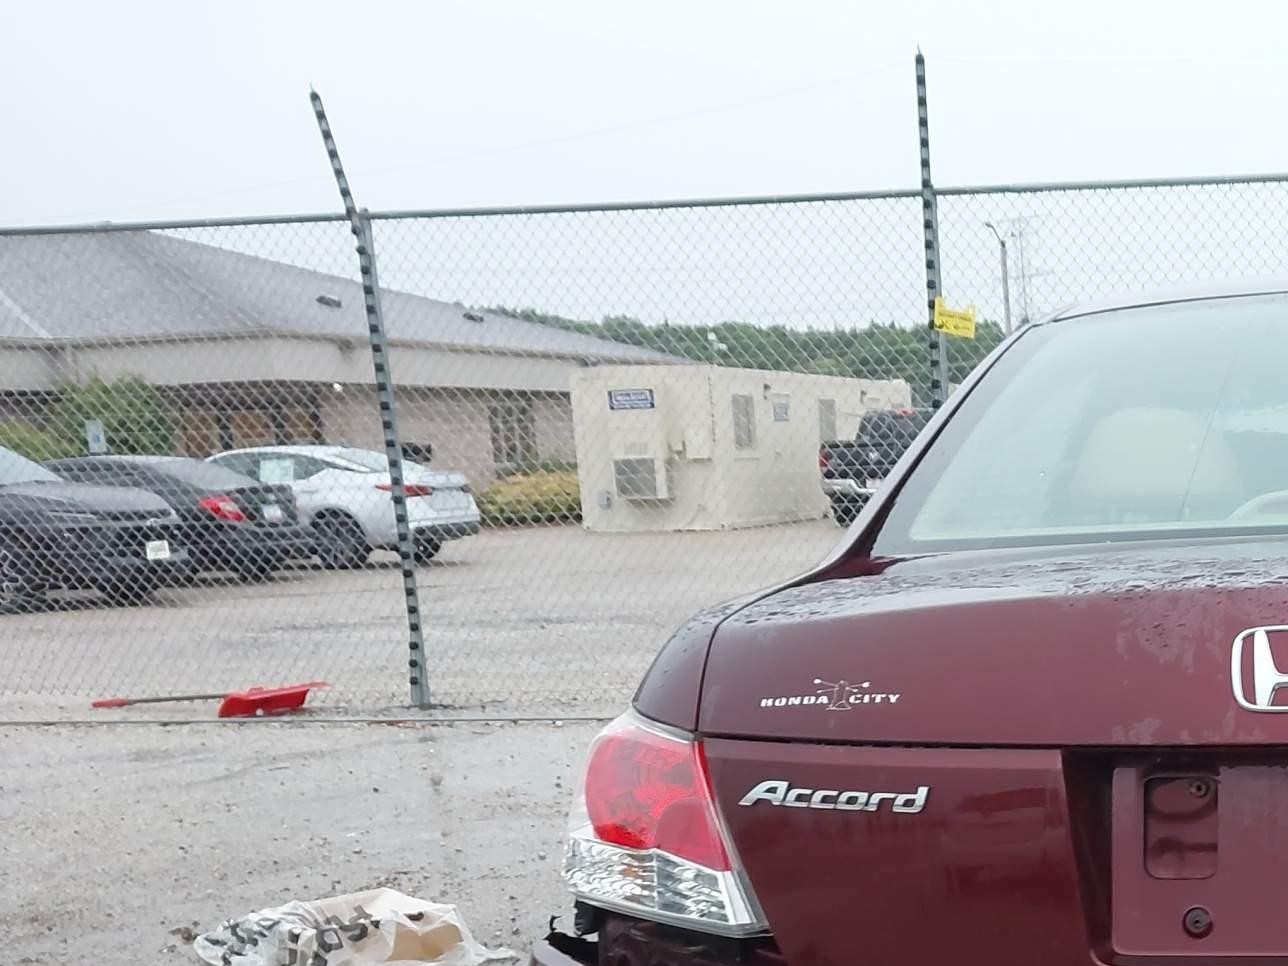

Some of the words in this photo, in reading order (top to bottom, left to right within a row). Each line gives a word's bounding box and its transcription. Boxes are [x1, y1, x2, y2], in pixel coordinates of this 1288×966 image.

[760, 694, 829, 708] HONDA
[849, 693, 901, 705] CITY
[738, 779, 930, 814] Accord
